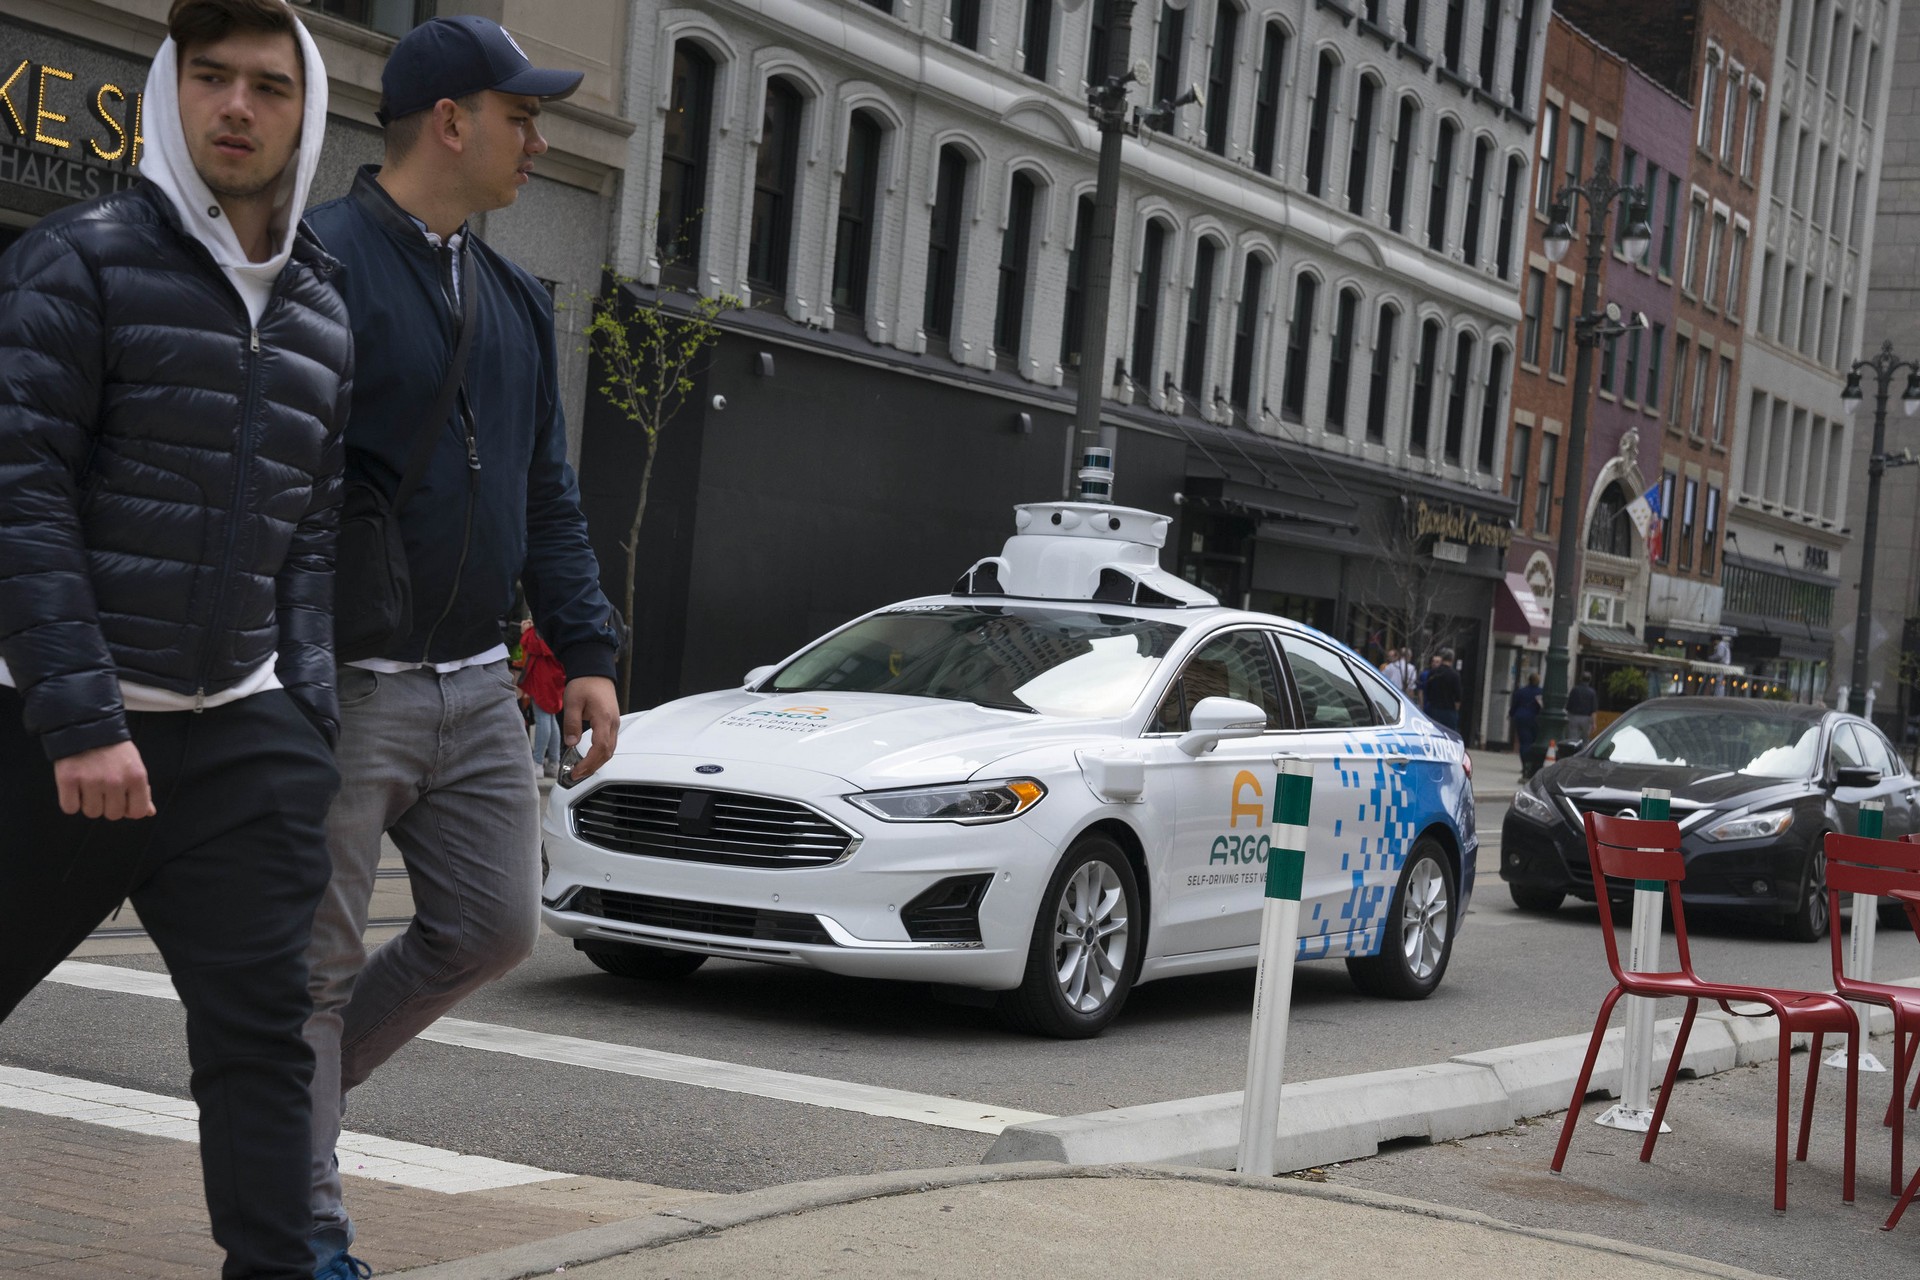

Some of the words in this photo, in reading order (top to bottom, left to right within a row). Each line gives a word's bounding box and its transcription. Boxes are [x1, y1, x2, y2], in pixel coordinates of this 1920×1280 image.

[0, 60, 74, 149] KE
[720, 720, 755, 728] TEST
[758, 724, 818, 733] VEHICLE
[1209, 834, 1271, 866] ARGO
[1187, 874, 1239, 886] SELF-DRIVING
[1241, 873, 1258, 883] TEST
